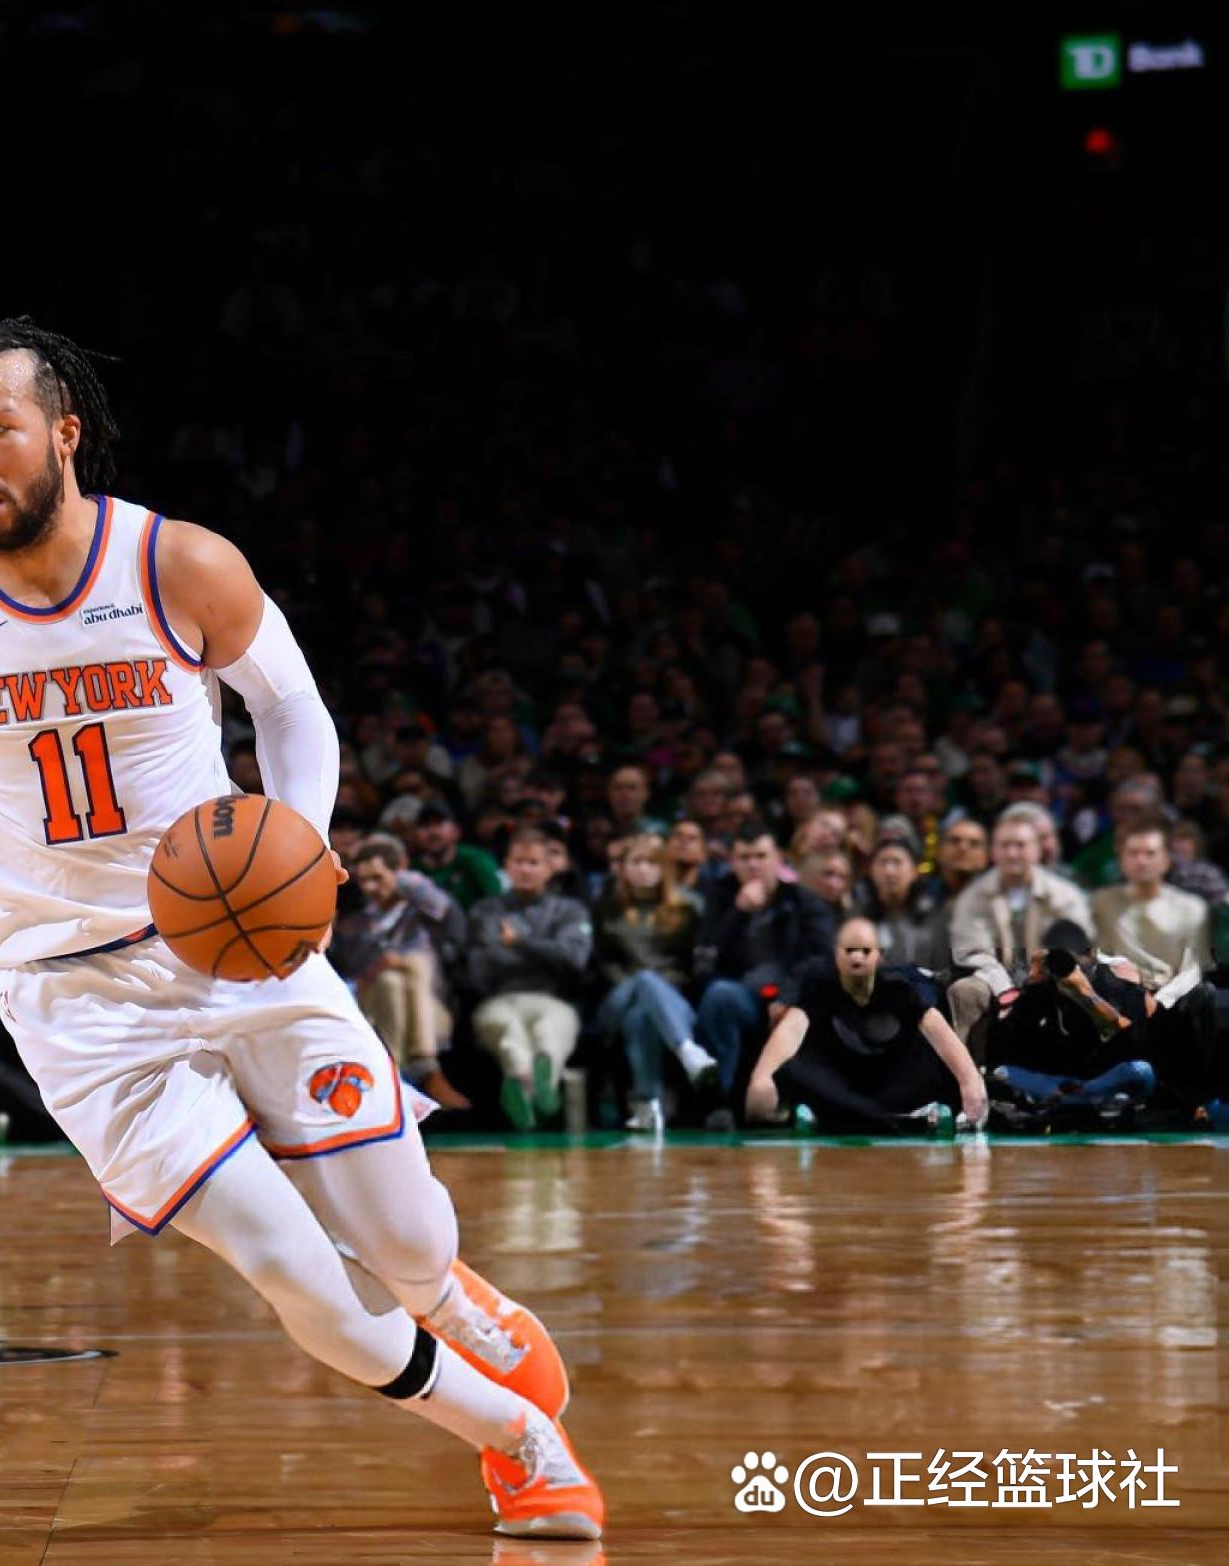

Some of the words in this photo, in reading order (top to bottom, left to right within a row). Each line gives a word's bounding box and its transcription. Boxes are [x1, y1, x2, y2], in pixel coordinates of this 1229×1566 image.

[1068, 44, 1116, 79] TD
[84, 613, 107, 625] abu
[109, 602, 143, 620] dhabi
[51, 659, 173, 716] YORK
[28, 722, 128, 846] 11
